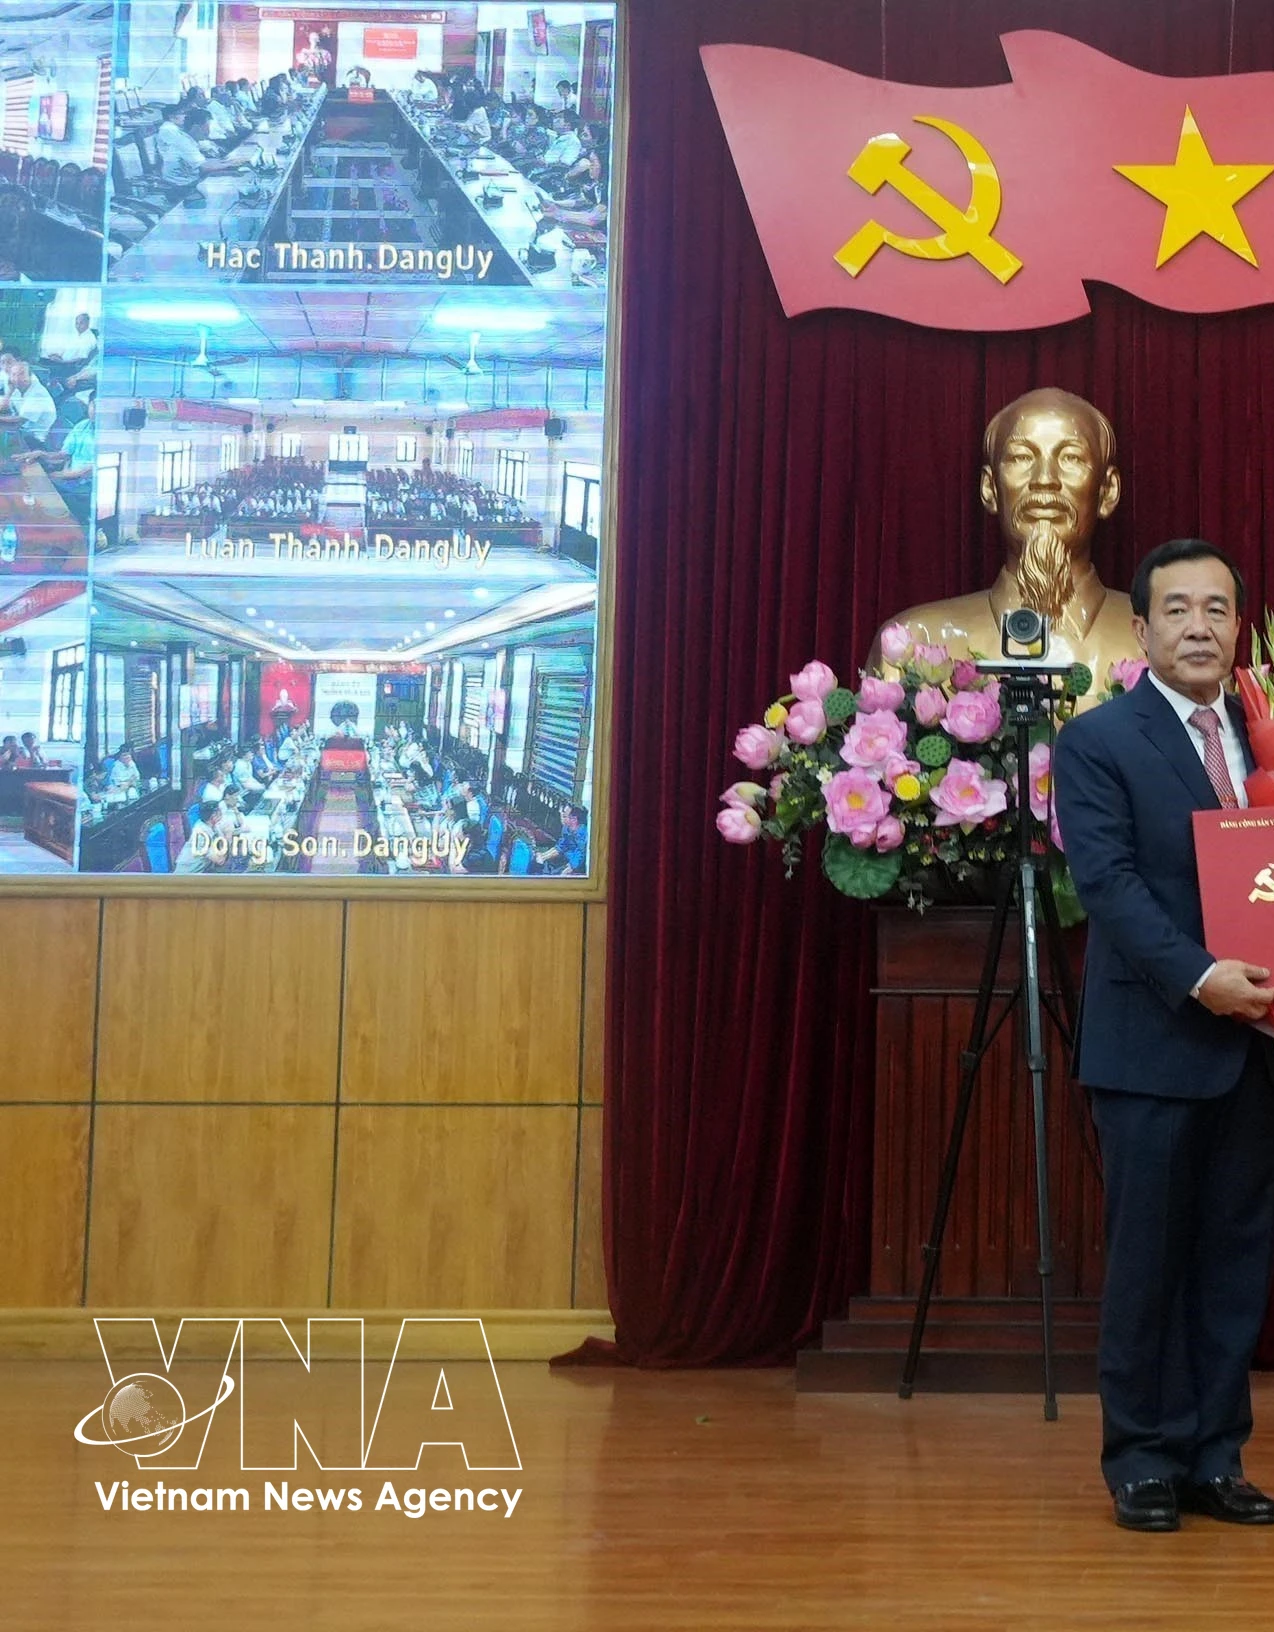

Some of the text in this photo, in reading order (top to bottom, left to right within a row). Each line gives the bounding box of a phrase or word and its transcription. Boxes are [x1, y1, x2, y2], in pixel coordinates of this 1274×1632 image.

[207, 242, 261, 269] Hac
[184, 532, 255, 561] Luan
[190, 830, 267, 864] Dong
